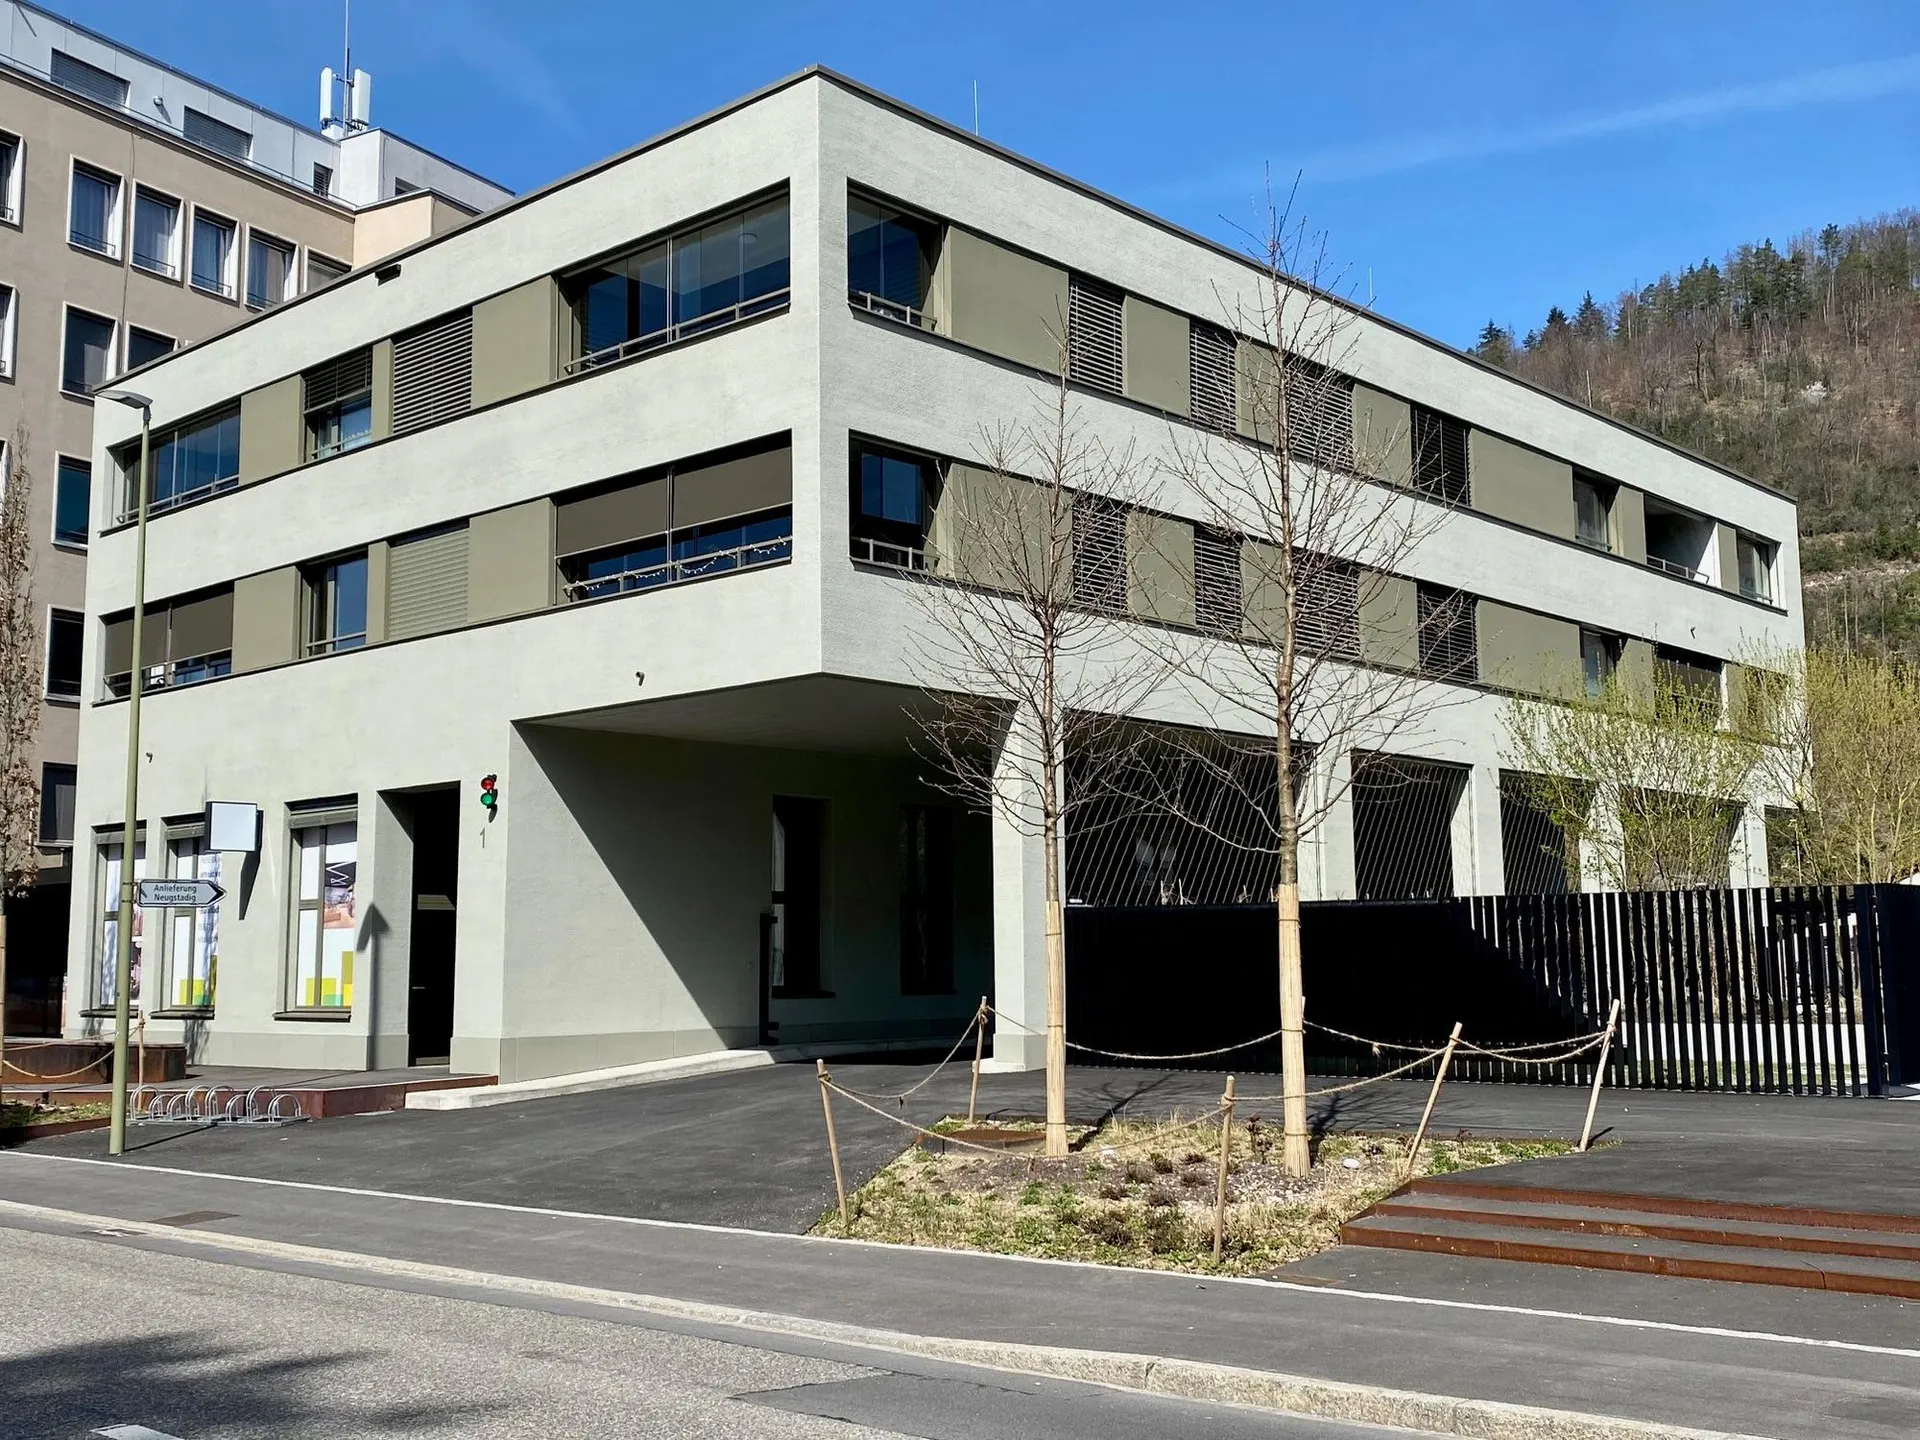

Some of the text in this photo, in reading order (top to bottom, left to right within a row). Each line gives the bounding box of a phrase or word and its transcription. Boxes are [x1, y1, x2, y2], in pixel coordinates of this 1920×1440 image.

[479, 827, 486, 849] 1
[153, 884, 197, 894] Anlieferung
[154, 894, 197, 903] Neugstadig
